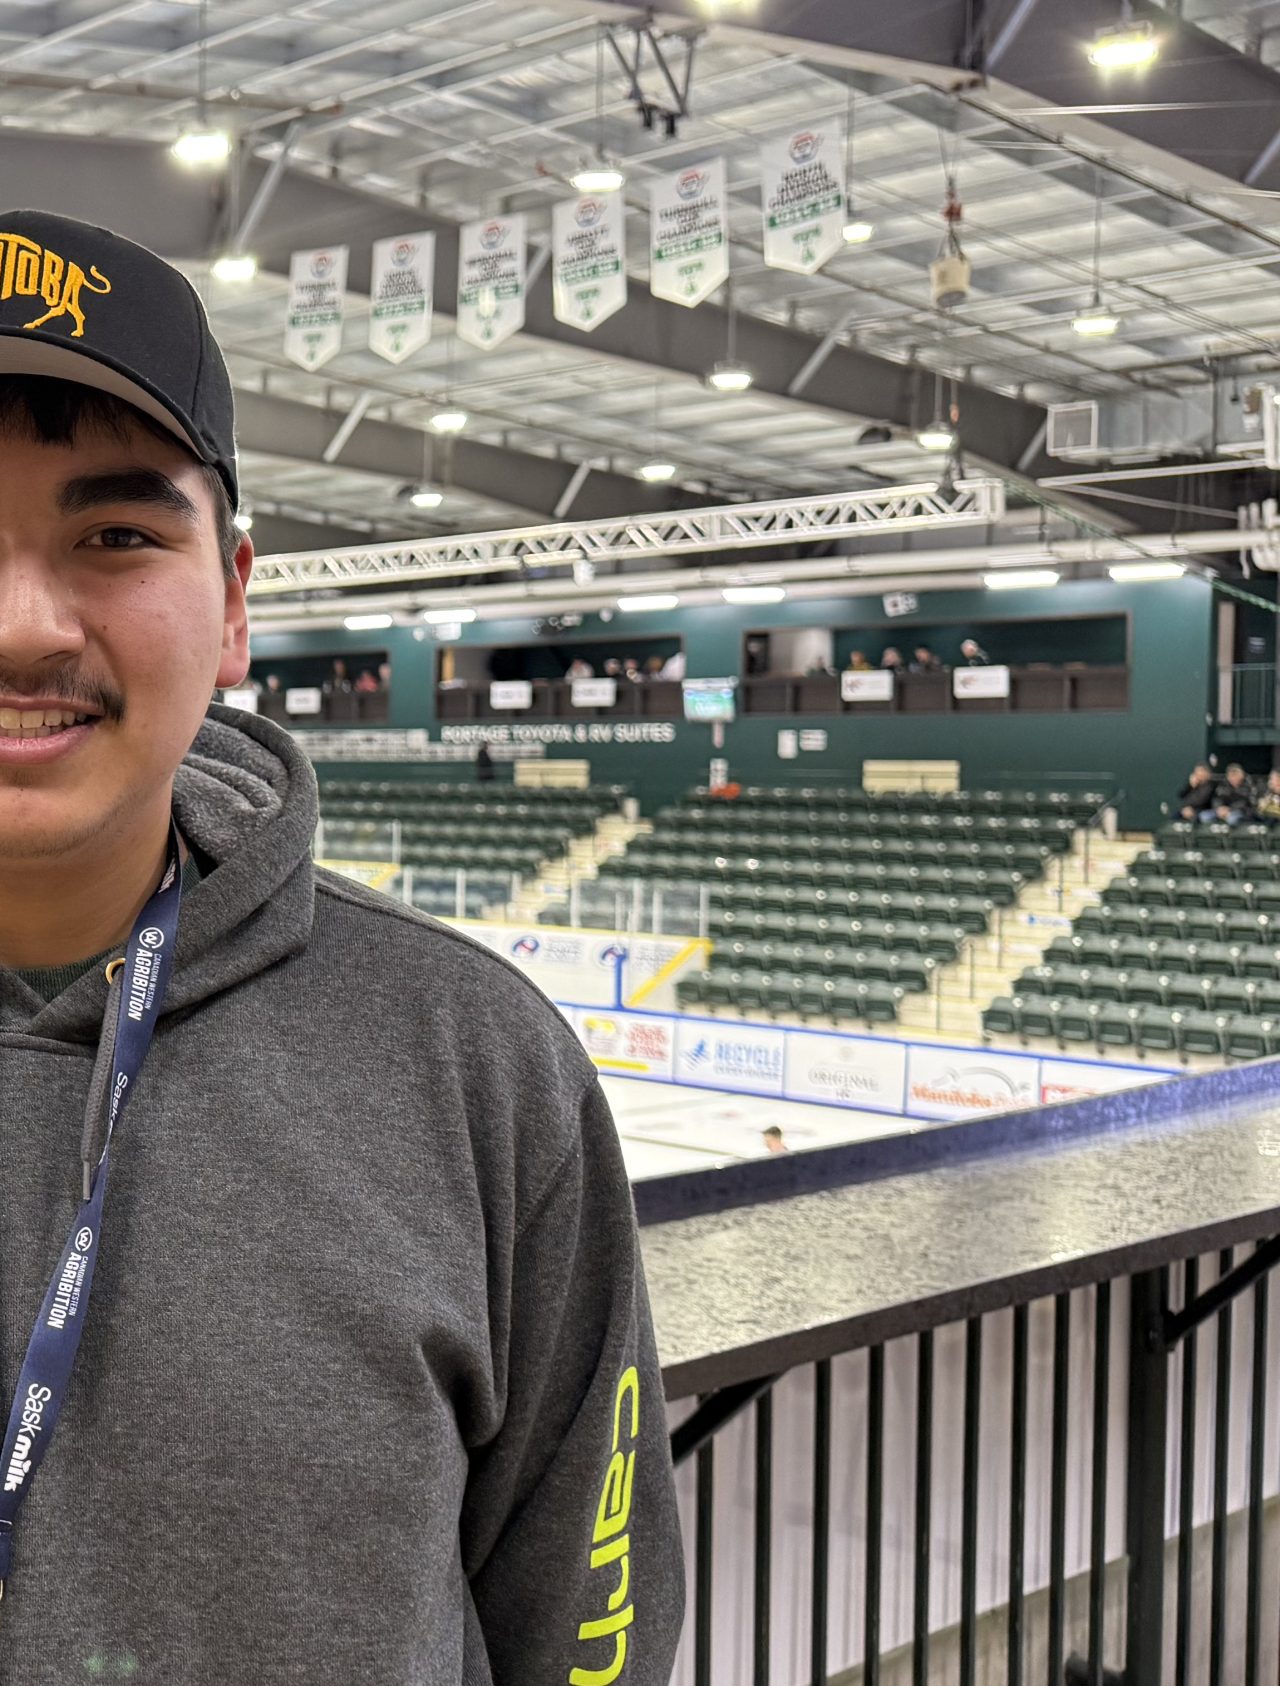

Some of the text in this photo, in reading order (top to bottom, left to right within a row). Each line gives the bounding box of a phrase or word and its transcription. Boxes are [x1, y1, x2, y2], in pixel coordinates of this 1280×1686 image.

[513, 724, 572, 744] TOYOTA
[613, 722, 676, 743] SUITES
[127, 948, 154, 1021] AGRIBITION
[145, 954, 162, 1010] CANADIAN WESTERN
[47, 1252, 81, 1329] AGRIBITION
[68, 1256, 88, 1316] CANADIAN WESTERN
